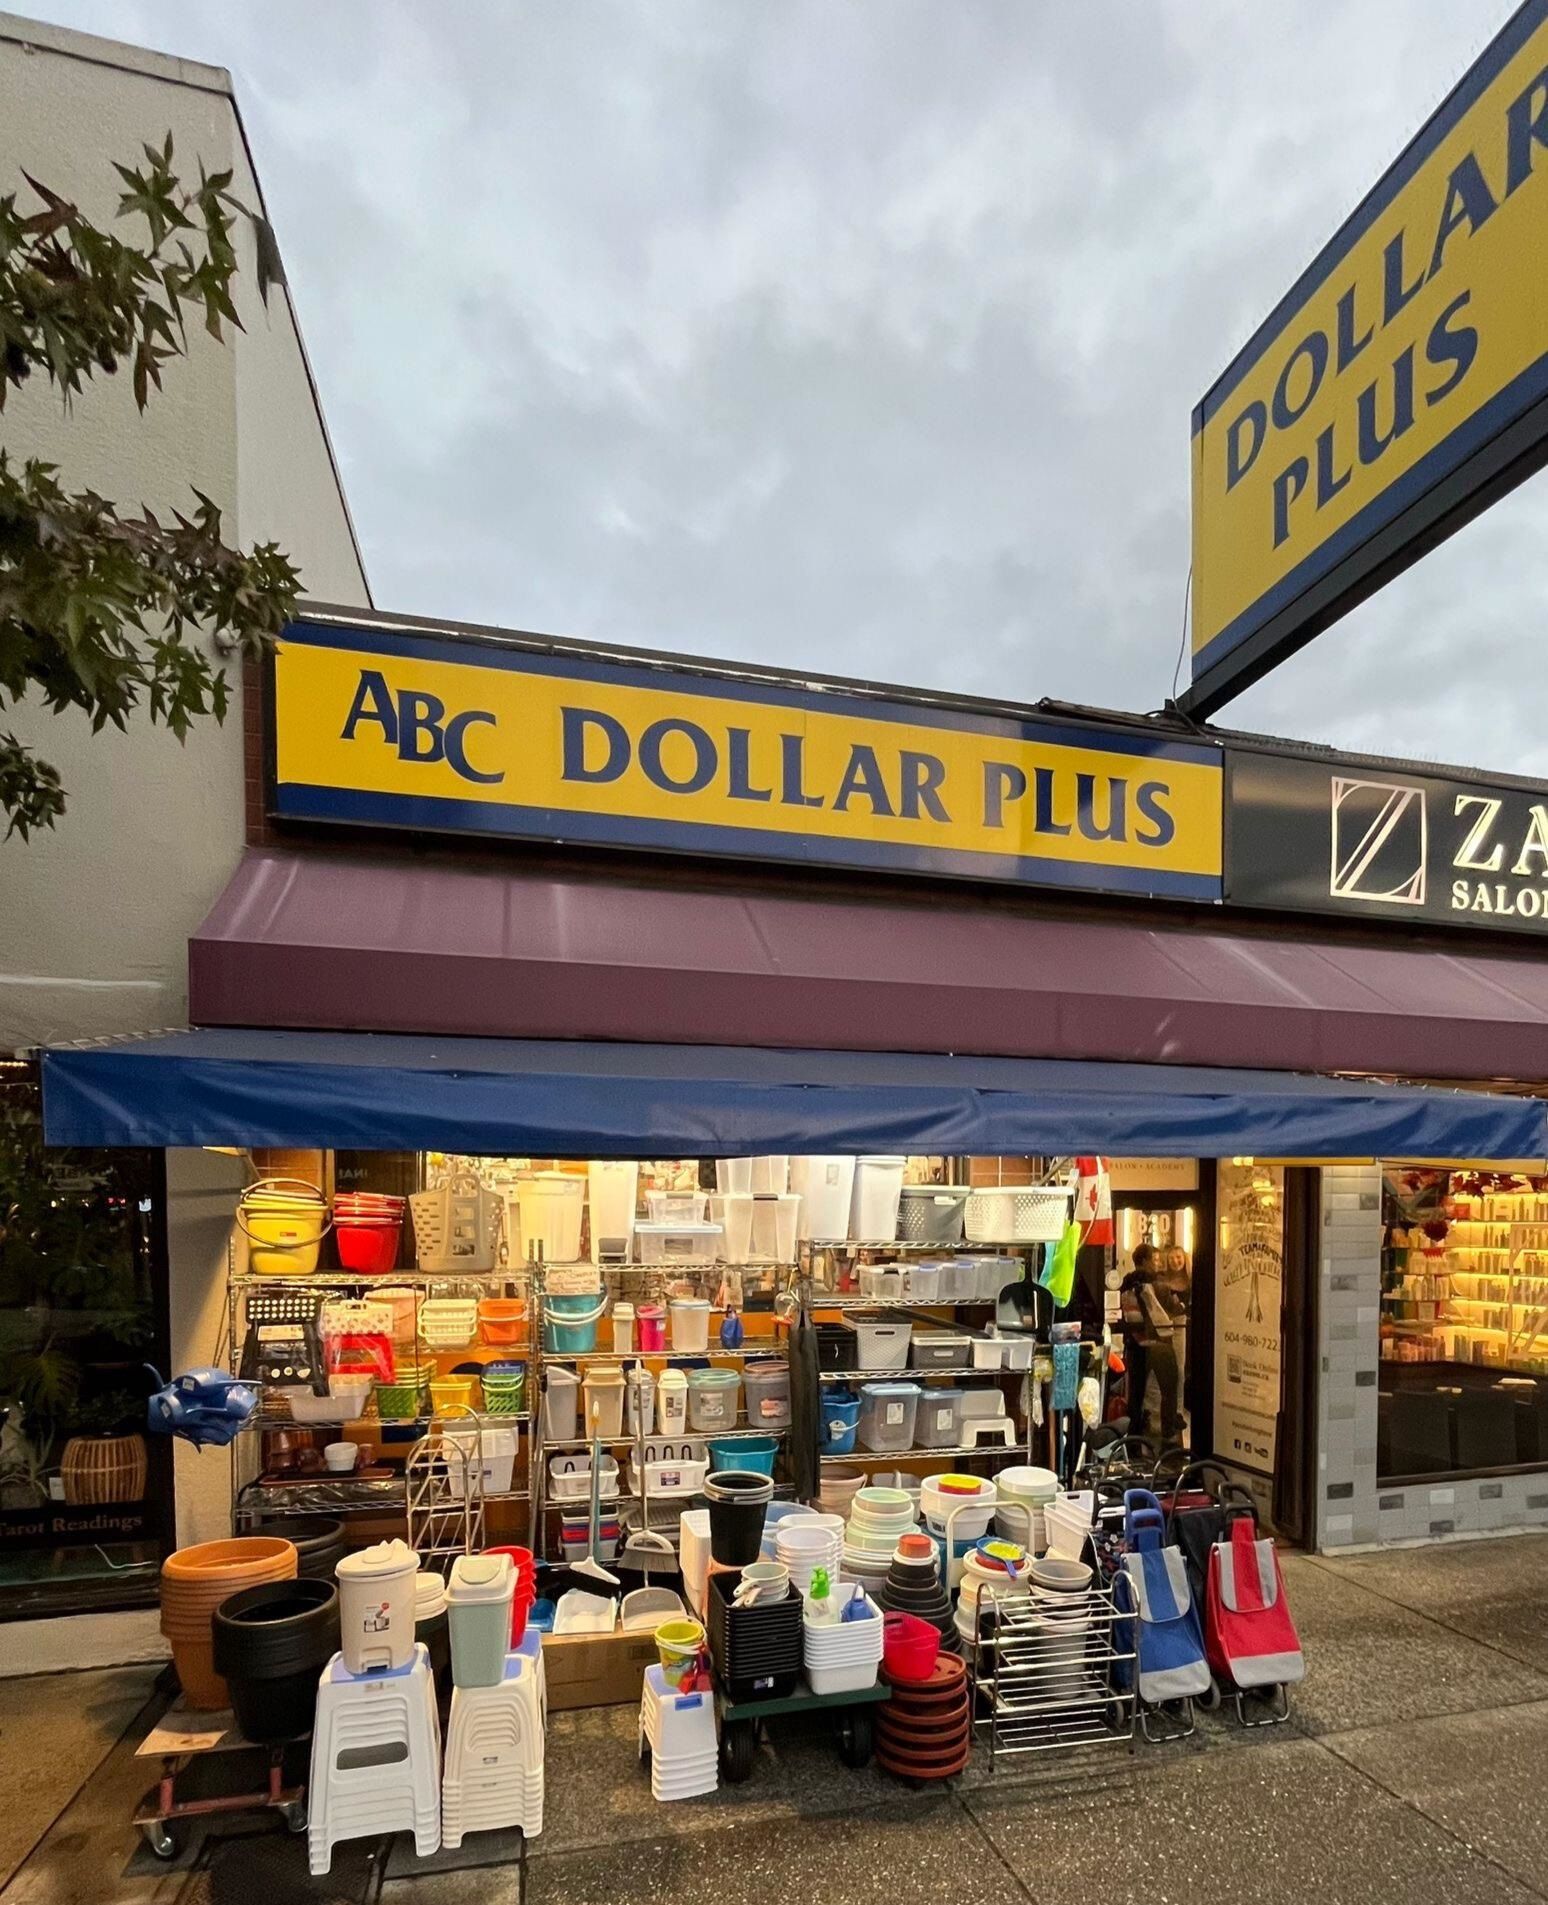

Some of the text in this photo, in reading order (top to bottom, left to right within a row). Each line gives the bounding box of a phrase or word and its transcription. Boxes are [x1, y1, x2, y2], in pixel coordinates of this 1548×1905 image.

[1225, 64, 1548, 494] DOLLAR
[1272, 291, 1479, 550] PLUS
[340, 669, 1175, 847] ABC DOLLAR PLUS
[1452, 880, 1548, 918] SALO
[1224, 1331, 1280, 1351] 604-980-722
[52, 1515, 142, 1532] Readings
